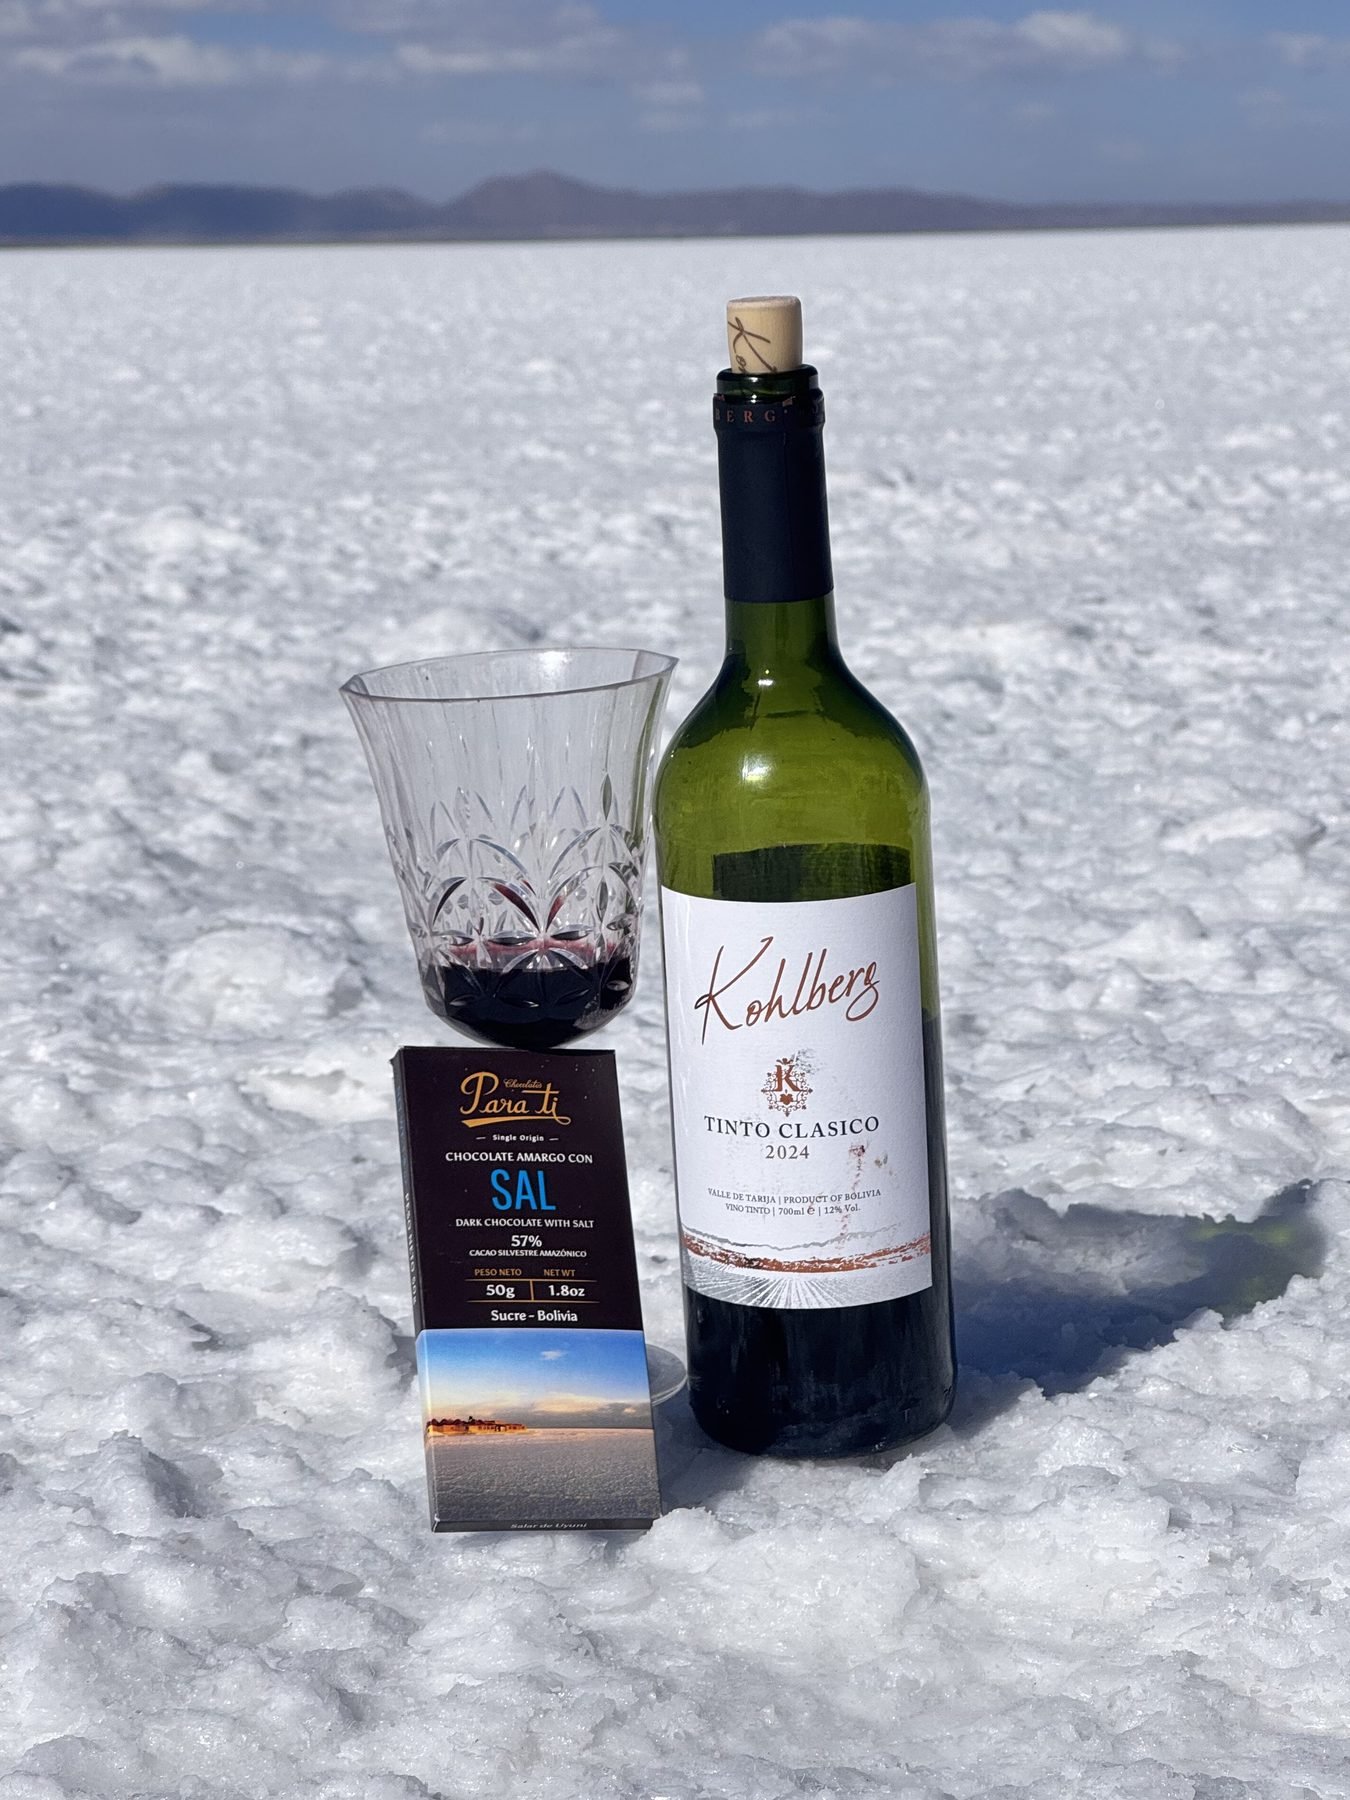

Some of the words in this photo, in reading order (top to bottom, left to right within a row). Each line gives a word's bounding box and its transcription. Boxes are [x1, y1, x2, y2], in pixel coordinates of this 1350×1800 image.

[694, 936, 880, 1045] Kohlberg
[459, 1071, 530, 1115] Para
[704, 1115, 771, 1139] TINTO
[778, 1116, 880, 1139] CLASICO
[492, 1134, 516, 1142] Single
[519, 1134, 545, 1143] Origin
[445, 1152, 515, 1162] CHOCOLATE
[516, 1153, 566, 1163] AMARGO
[568, 1153, 593, 1164] CON
[765, 1144, 810, 1160] 2024
[490, 1168, 556, 1211] SAL
[707, 1187, 732, 1200] VALLE
[732, 1192, 745, 1202] DE
[783, 1194, 829, 1205] PRODUCT
[830, 1193, 843, 1203] OF
[844, 1188, 882, 1202] BOLIVIA
[725, 1202, 745, 1212] VINO
[745, 1204, 771, 1215] TINTO
[778, 1206, 805, 1216] 700ml
[824, 1204, 843, 1215] 12%
[844, 1203, 861, 1213] Vol.
[455, 1218, 483, 1228] DARK
[484, 1218, 543, 1228] CHOCOLATE
[544, 1219, 571, 1229] WITH
[572, 1219, 595, 1229] SALT
[510, 1234, 543, 1248] 57%
[468, 1249, 497, 1257] CACAO
[497, 1249, 538, 1257] SILVESTRE
[539, 1248, 588, 1258] AMAZÓNICO
[474, 1268, 497, 1276] PESO
[498, 1268, 523, 1276] NETO
[543, 1269, 560, 1277] NET
[561, 1269, 576, 1277] WT
[485, 1284, 516, 1299] 50g
[548, 1285, 586, 1297] 1.8oz
[490, 1310, 527, 1322] Sucre
[537, 1310, 579, 1322] Bolivia
